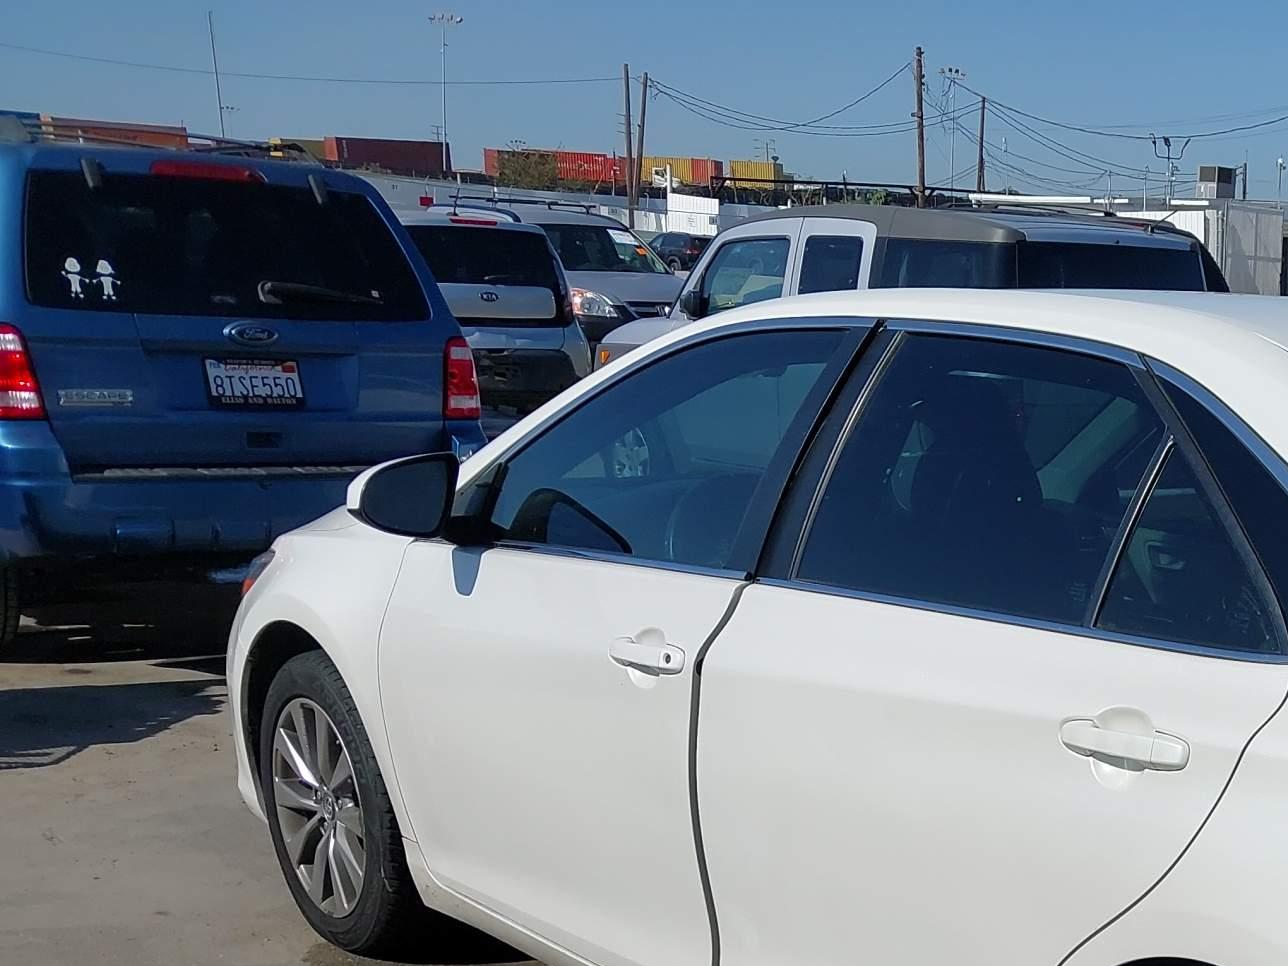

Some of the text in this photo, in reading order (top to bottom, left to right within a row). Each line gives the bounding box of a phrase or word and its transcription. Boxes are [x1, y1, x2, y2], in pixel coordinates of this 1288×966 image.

[482, 293, 497, 301] KIA
[243, 328, 268, 340] Ford
[213, 375, 298, 398] 8TSE550
